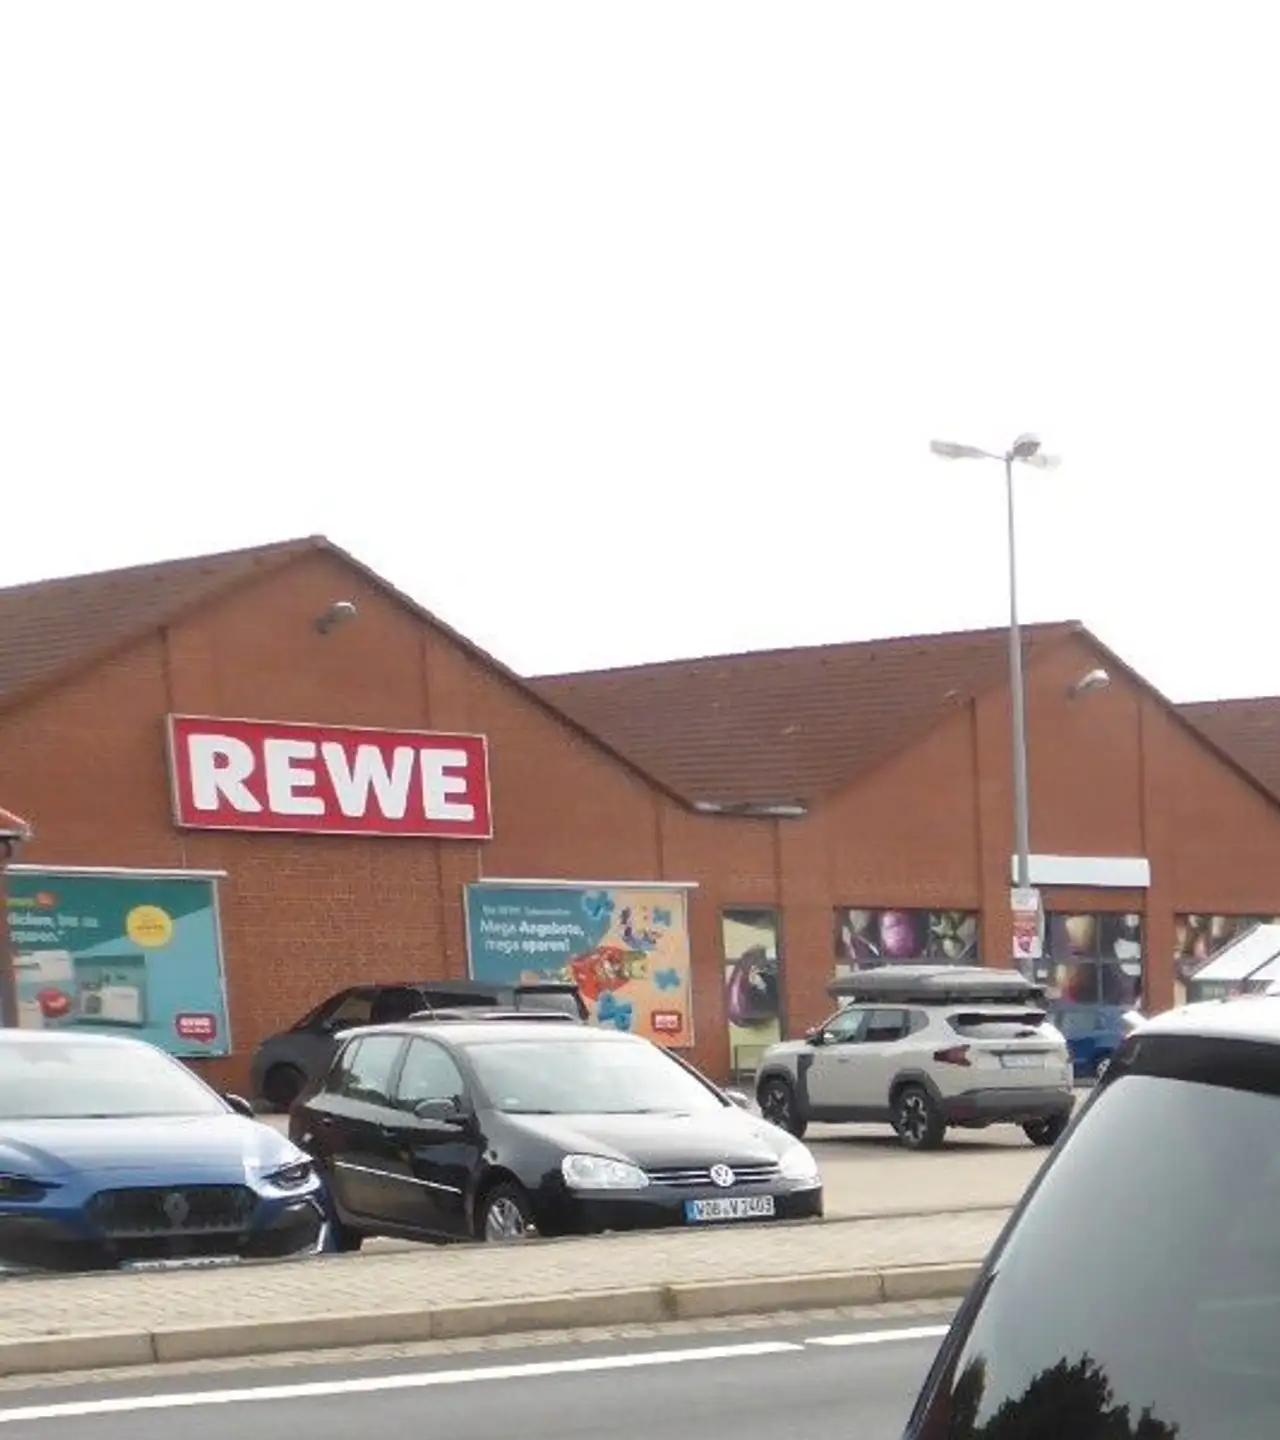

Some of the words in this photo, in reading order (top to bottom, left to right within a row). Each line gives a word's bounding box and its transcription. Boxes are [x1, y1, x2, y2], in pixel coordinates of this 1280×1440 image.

[187, 733, 475, 821] REWE
[480, 918, 517, 938] Mega
[518, 919, 585, 938] Angebote,
